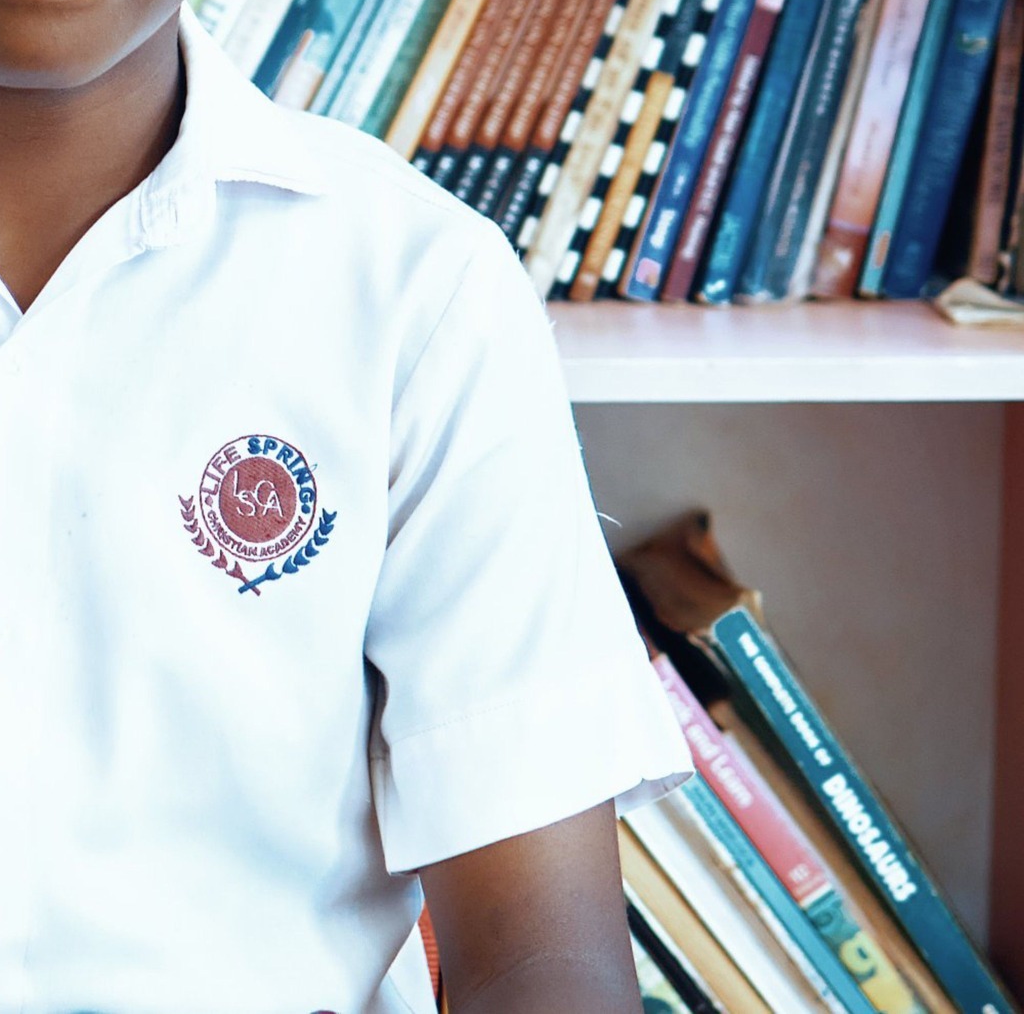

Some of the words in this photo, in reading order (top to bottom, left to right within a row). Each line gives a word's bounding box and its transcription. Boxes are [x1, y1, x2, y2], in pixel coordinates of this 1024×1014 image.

[201, 446, 241, 495] LIFE
[247, 438, 315, 503] SPRING
[207, 510, 258, 556] CHRISTIAN
[260, 516, 306, 556] ACADEMY
[685, 720, 721, 761] and
[819, 771, 920, 902] DINOSAURS
